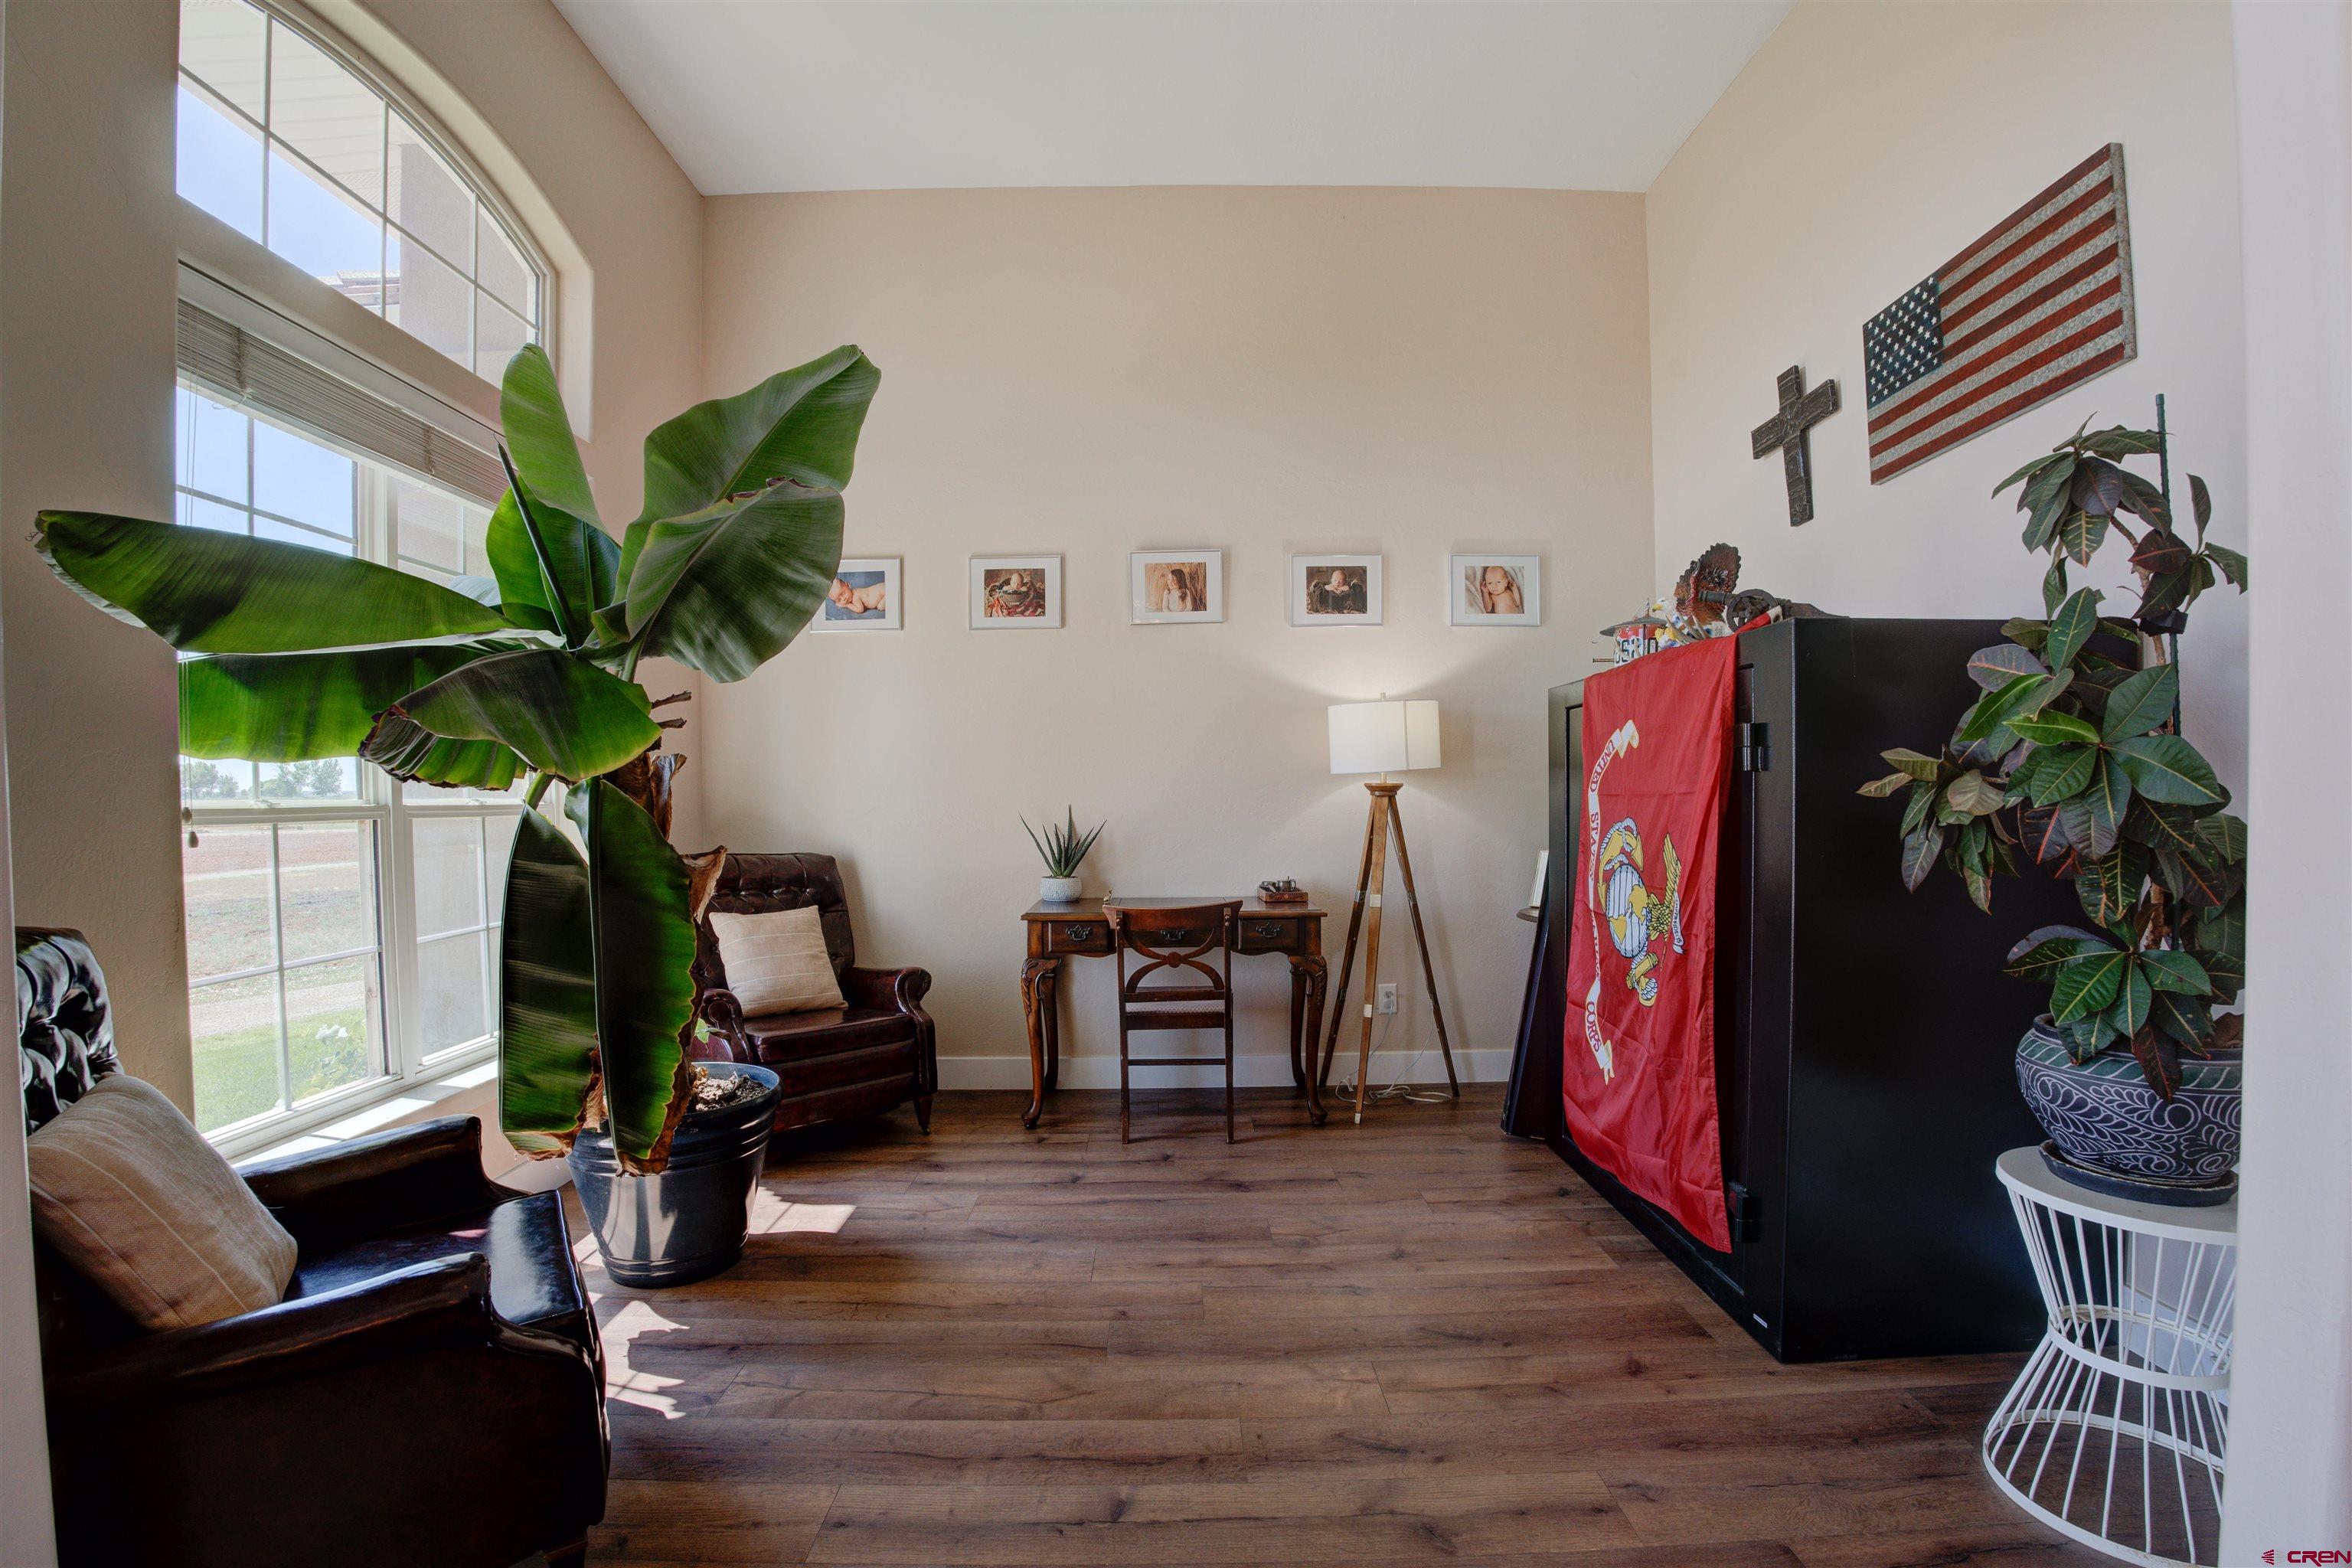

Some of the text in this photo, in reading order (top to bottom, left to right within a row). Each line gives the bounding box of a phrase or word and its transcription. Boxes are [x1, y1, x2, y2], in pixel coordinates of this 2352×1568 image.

[1586, 739, 1615, 1052] UNITED STAT CORPS
